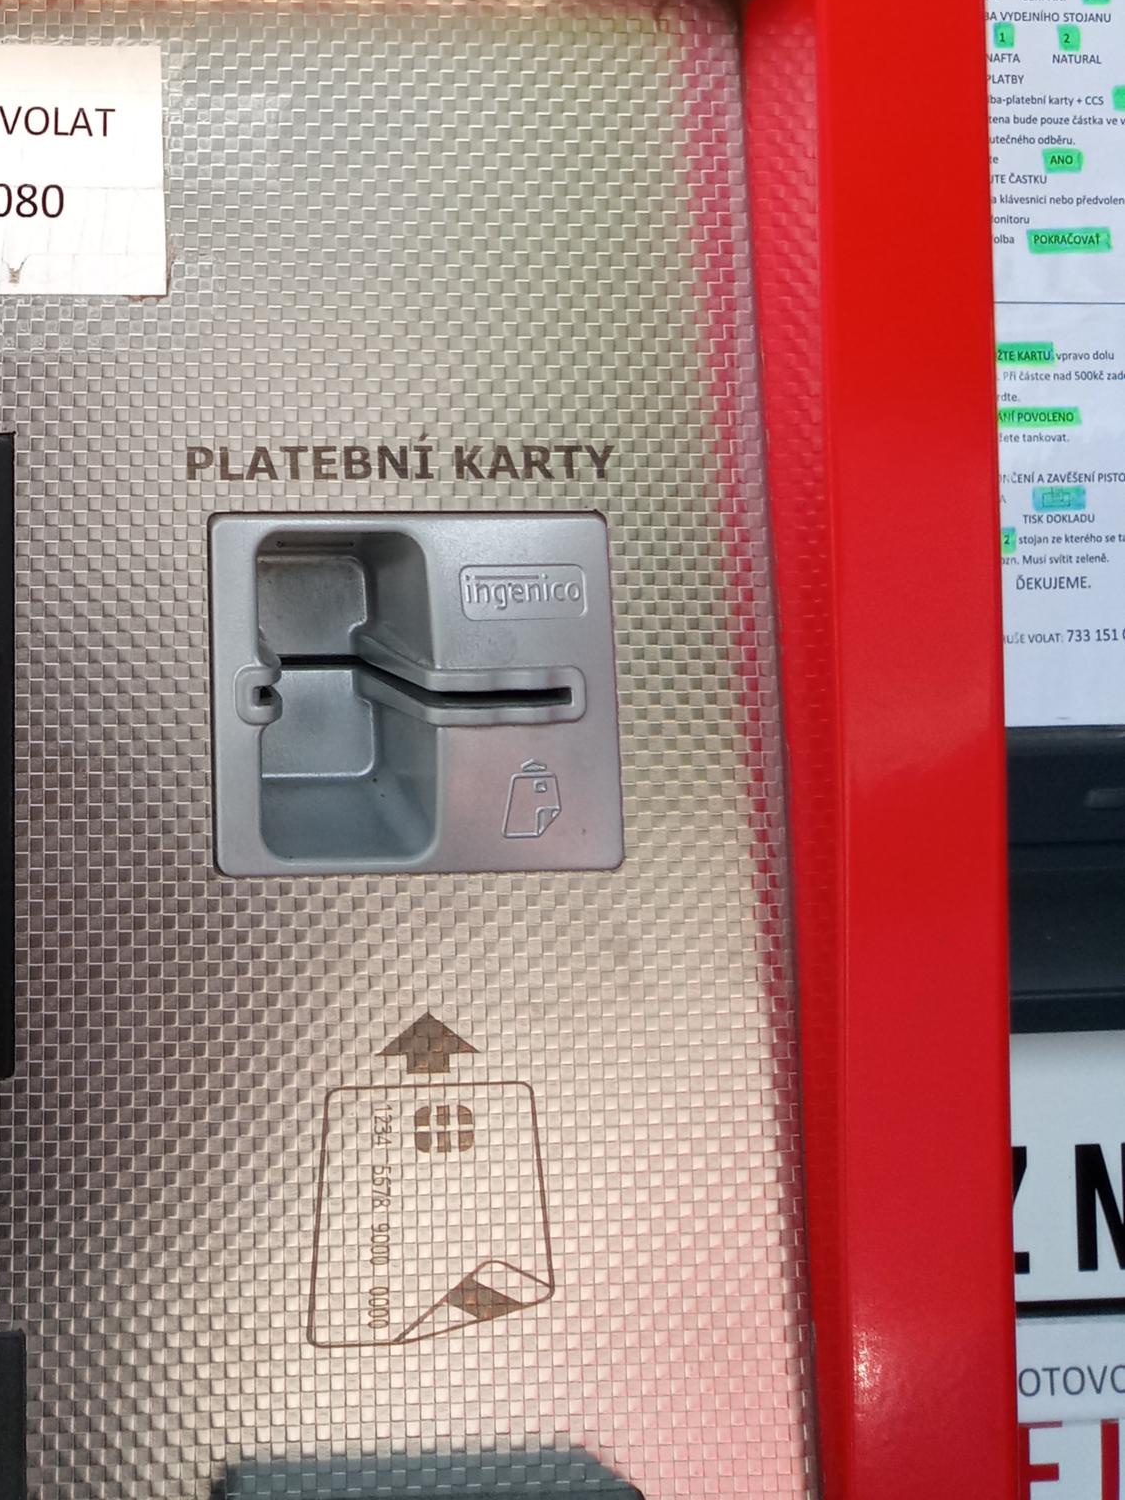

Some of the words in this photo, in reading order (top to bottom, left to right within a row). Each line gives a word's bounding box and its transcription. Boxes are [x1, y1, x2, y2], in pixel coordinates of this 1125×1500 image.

[1063, 12, 1111, 23] STOJANU
[1000, 33, 1005, 42] 1
[1064, 33, 1070, 43] 2
[1052, 54, 1102, 64] NATURAL
[1049, 96, 1073, 107] karty
[1085, 96, 1104, 106] CCS
[0, 105, 116, 137] VOLAT
[1013, 114, 1038, 124] bude
[1040, 116, 1070, 126] pouze
[1072, 116, 1104, 125] částka
[1037, 134, 1075, 145] odběru.
[1050, 155, 1073, 165] ANO
[999, 194, 1047, 205] klávesnici
[1049, 195, 1074, 205] nebo
[991, 215, 1030, 224] onitoru
[993, 234, 1015, 244] olba
[1056, 352, 1090, 362] vpravo
[1093, 351, 1115, 360] dolu
[1019, 371, 1050, 381] částce
[1053, 371, 1072, 381] nad
[1075, 370, 1104, 381] 500kč
[1017, 412, 1074, 422] POVOLENO
[1023, 432, 1070, 443] tankovat.
[185, 434, 433, 480] PLATEBNÍ
[454, 444, 615, 480] KARTY
[1000, 472, 1035, 484] NČENÍ
[1037, 474, 1045, 483] A
[1047, 471, 1096, 483] ZAVĚŠENÍ
[1023, 514, 1044, 524] TISK
[1047, 514, 1095, 524] DOKLADU
[1004, 535, 1010, 545] 2
[1019, 535, 1049, 546] stojan
[1051, 536, 1062, 544] ze
[1065, 534, 1102, 544] kterého
[1105, 535, 1115, 543] se
[1023, 554, 1047, 565] Musí
[1076, 554, 1109, 564] zeleně.
[465, 573, 581, 608] ingenico
[1067, 629, 1091, 643] 733
[1095, 628, 1119, 642] 151
[374, 1104, 393, 1147] 1234
[372, 1165, 392, 1209] 5678
[369, 1223, 391, 1266] 9000
[368, 1286, 389, 1329] 0000
